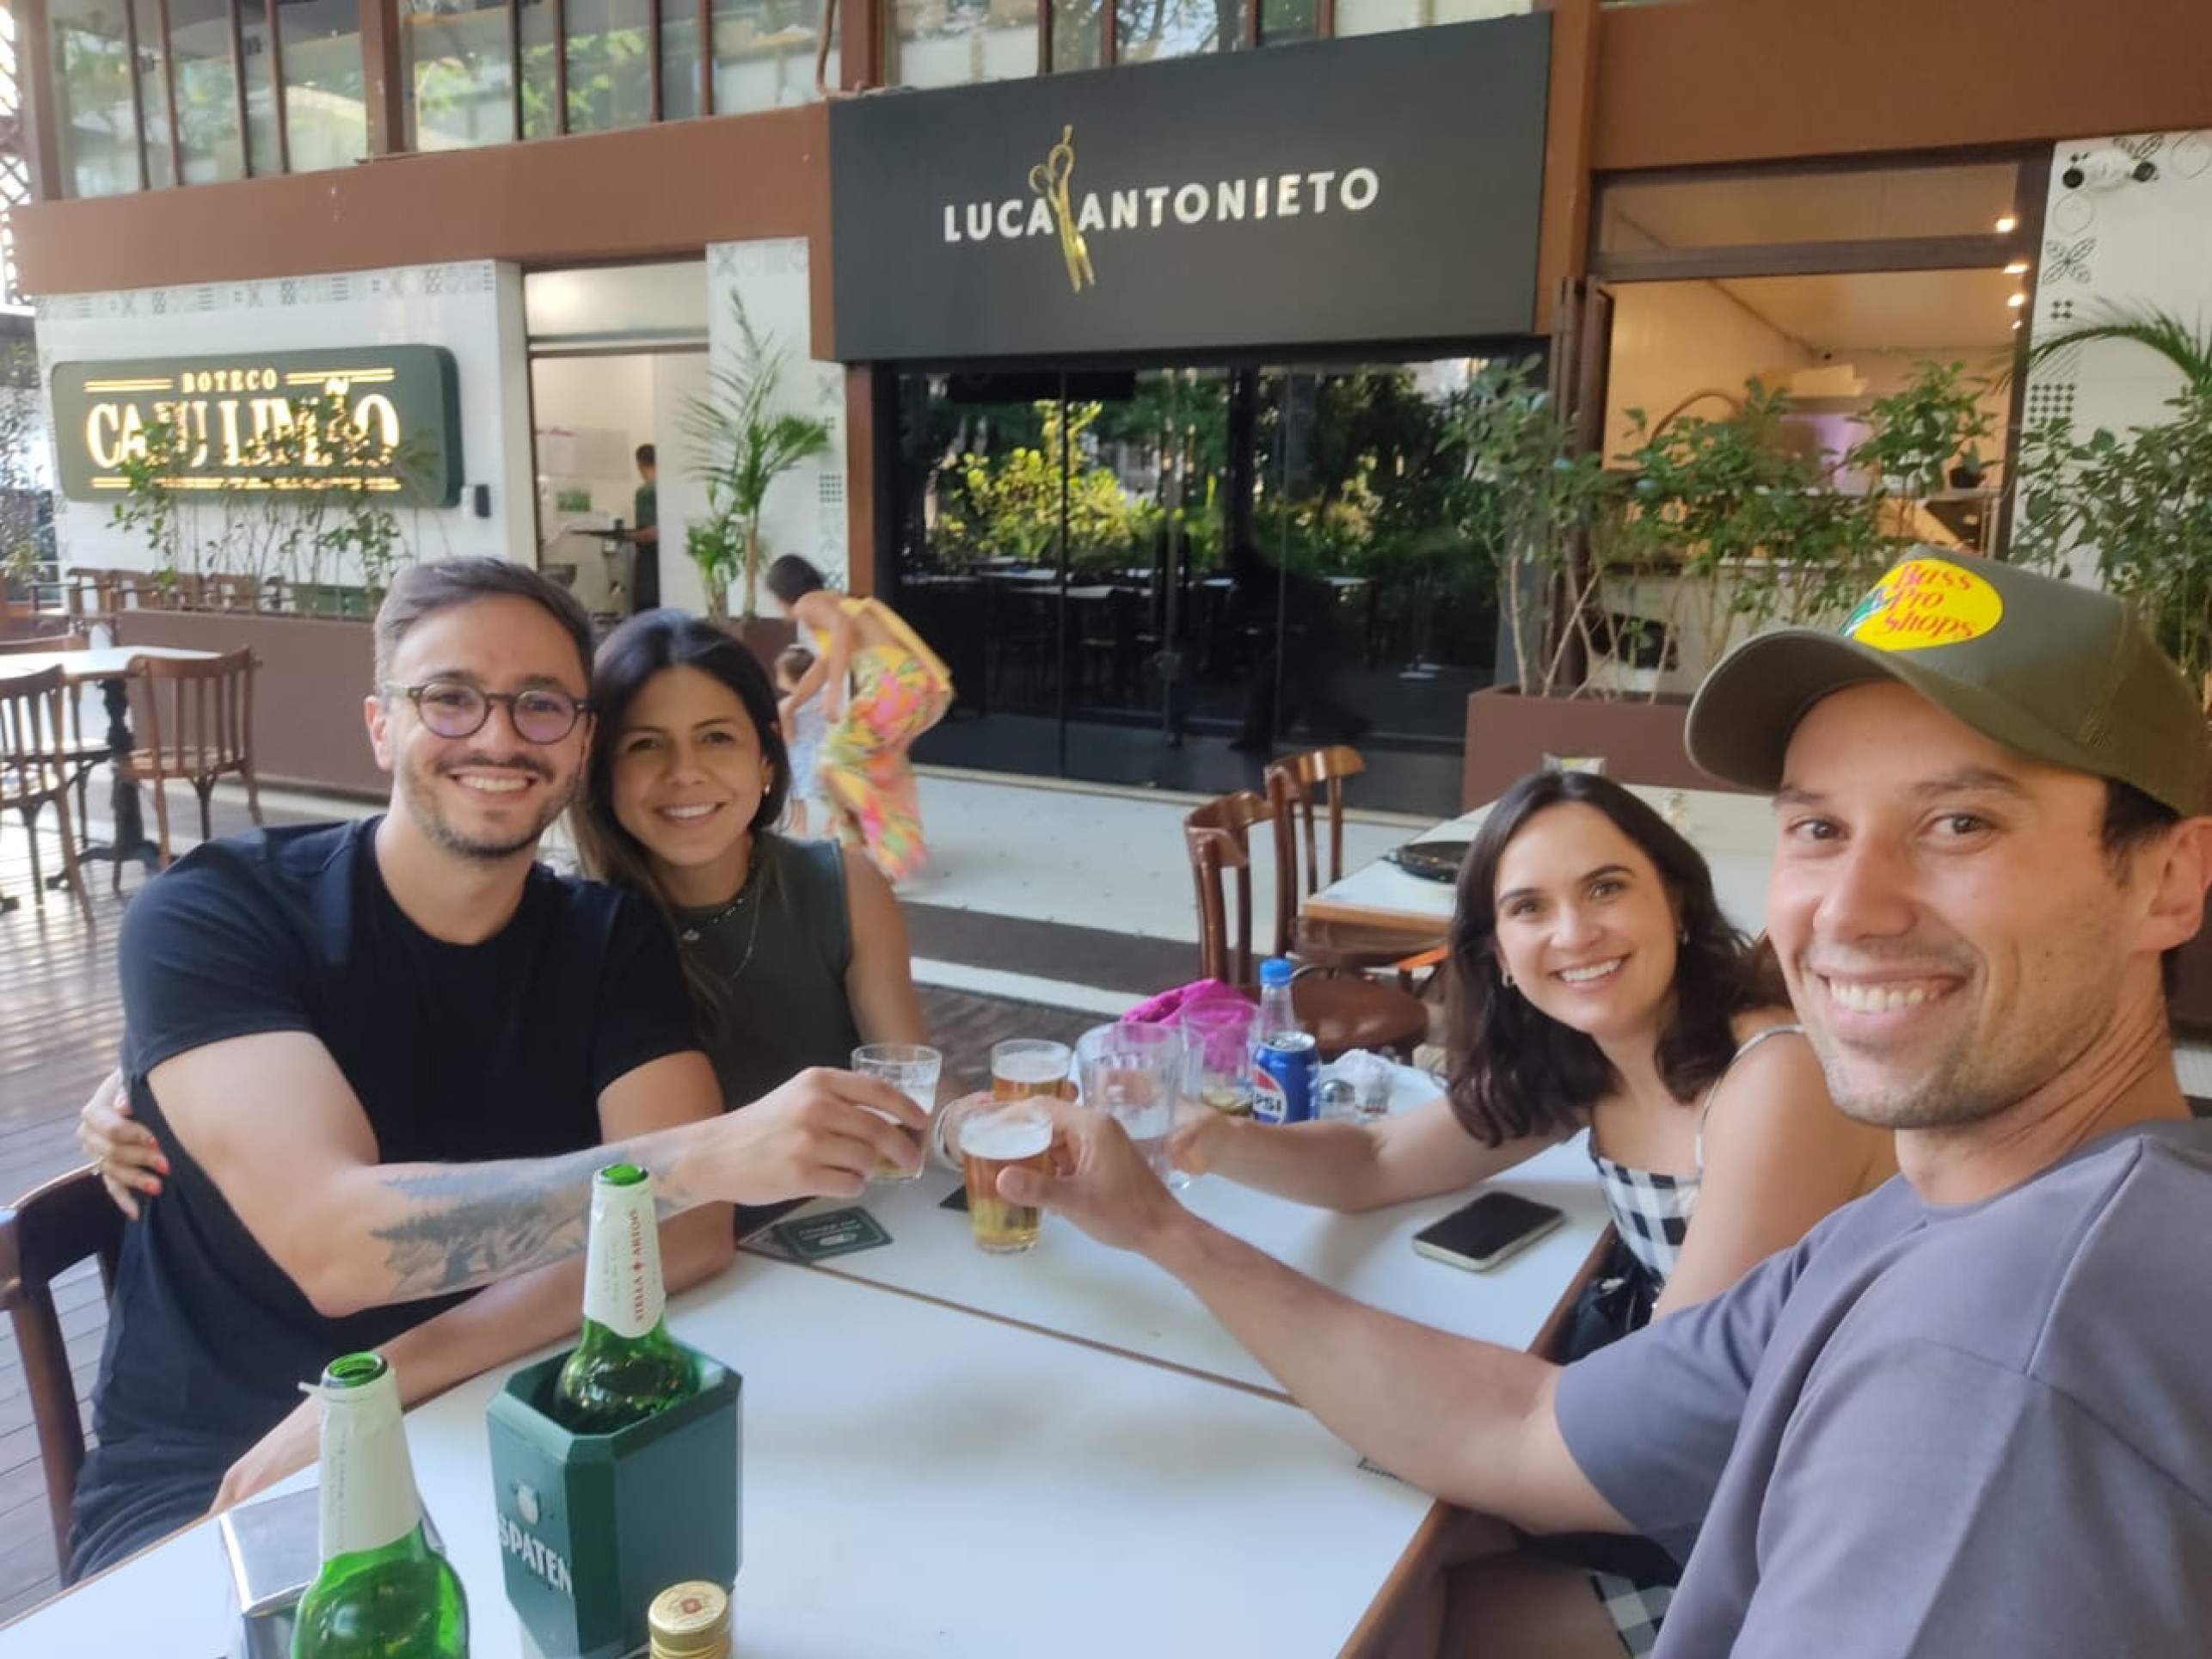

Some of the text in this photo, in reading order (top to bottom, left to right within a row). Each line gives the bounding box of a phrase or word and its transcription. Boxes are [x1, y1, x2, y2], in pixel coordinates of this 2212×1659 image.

[943, 167, 1379, 243] LUCA ANTONIETO
[181, 367, 279, 393] BOTECO
[1888, 587, 1945, 611] Pro
[498, 1516, 573, 1597] SPATEN
